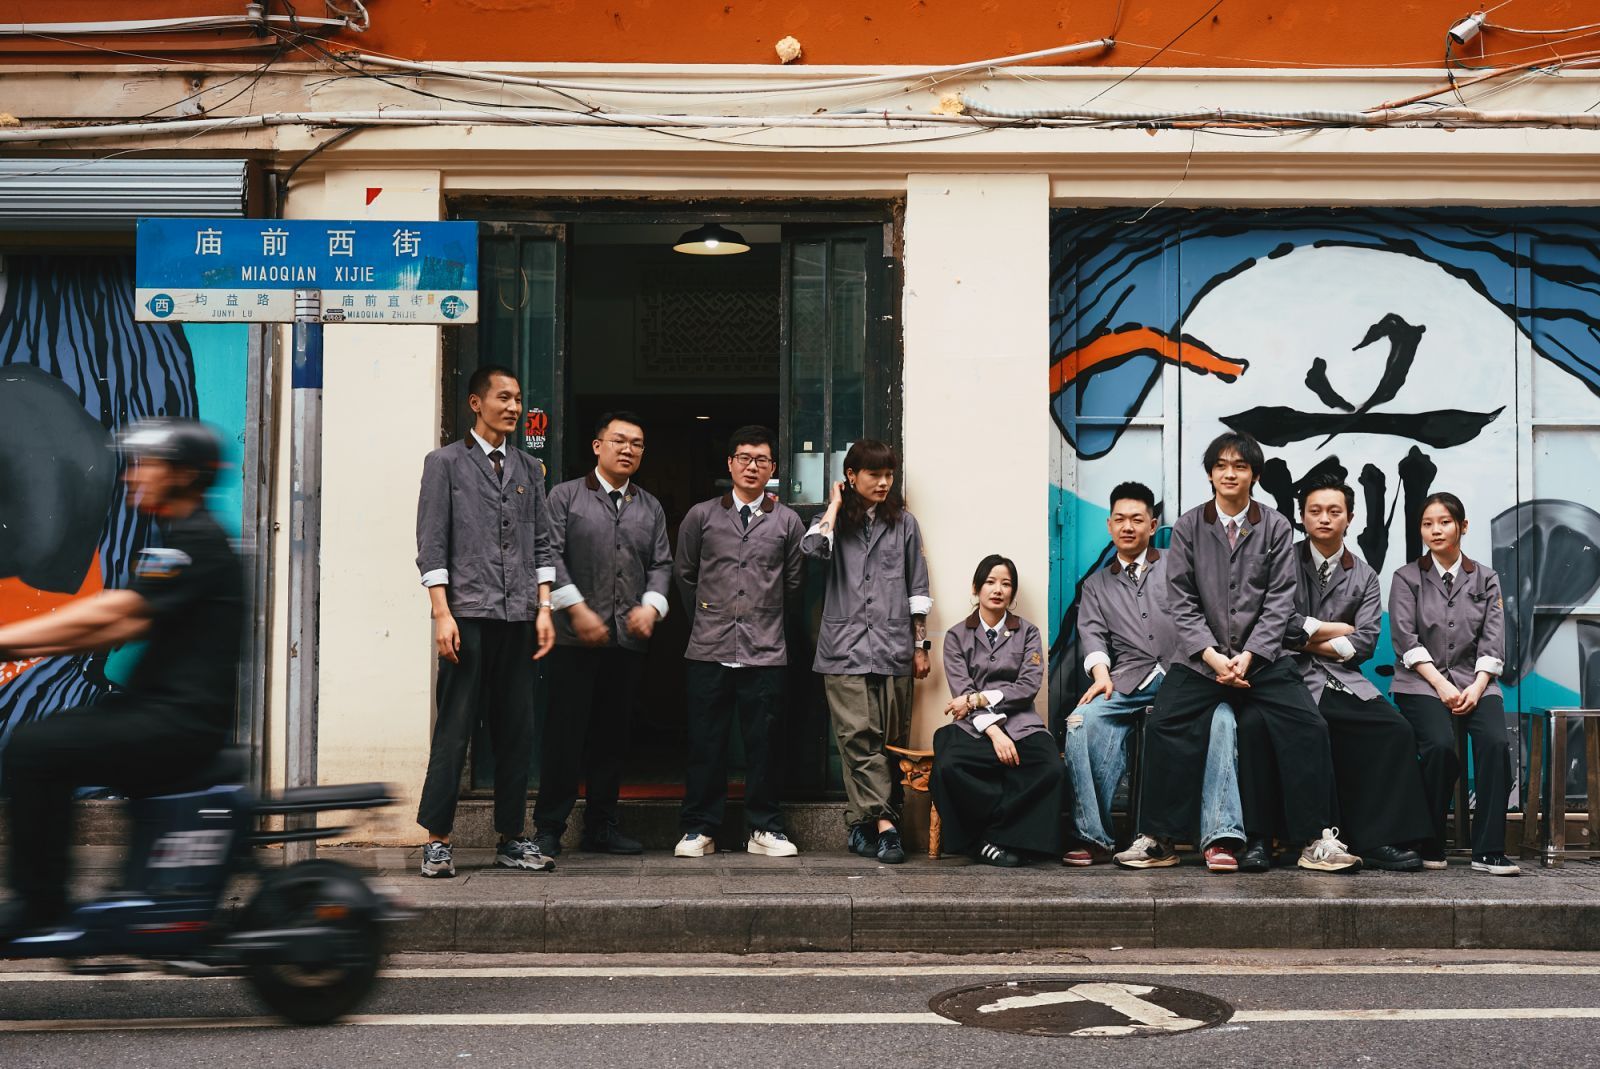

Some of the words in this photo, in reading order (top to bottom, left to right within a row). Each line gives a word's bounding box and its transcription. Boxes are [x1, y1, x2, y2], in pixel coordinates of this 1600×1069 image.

[195, 228, 422, 257] 庙前西街
[241, 266, 316, 282] MIAOQIAN
[335, 266, 375, 282] XIJIE
[155, 298, 169, 313] 西
[195, 293, 270, 307] 均益路
[342, 294, 424, 308] 庙前直街
[211, 310, 235, 318] JUNYI
[242, 310, 253, 318] LU
[445, 301, 457, 314] 东
[347, 311, 384, 319] MIAOQIAN
[392, 311, 417, 319] ZHIJIE
[525, 412, 548, 431] 50
